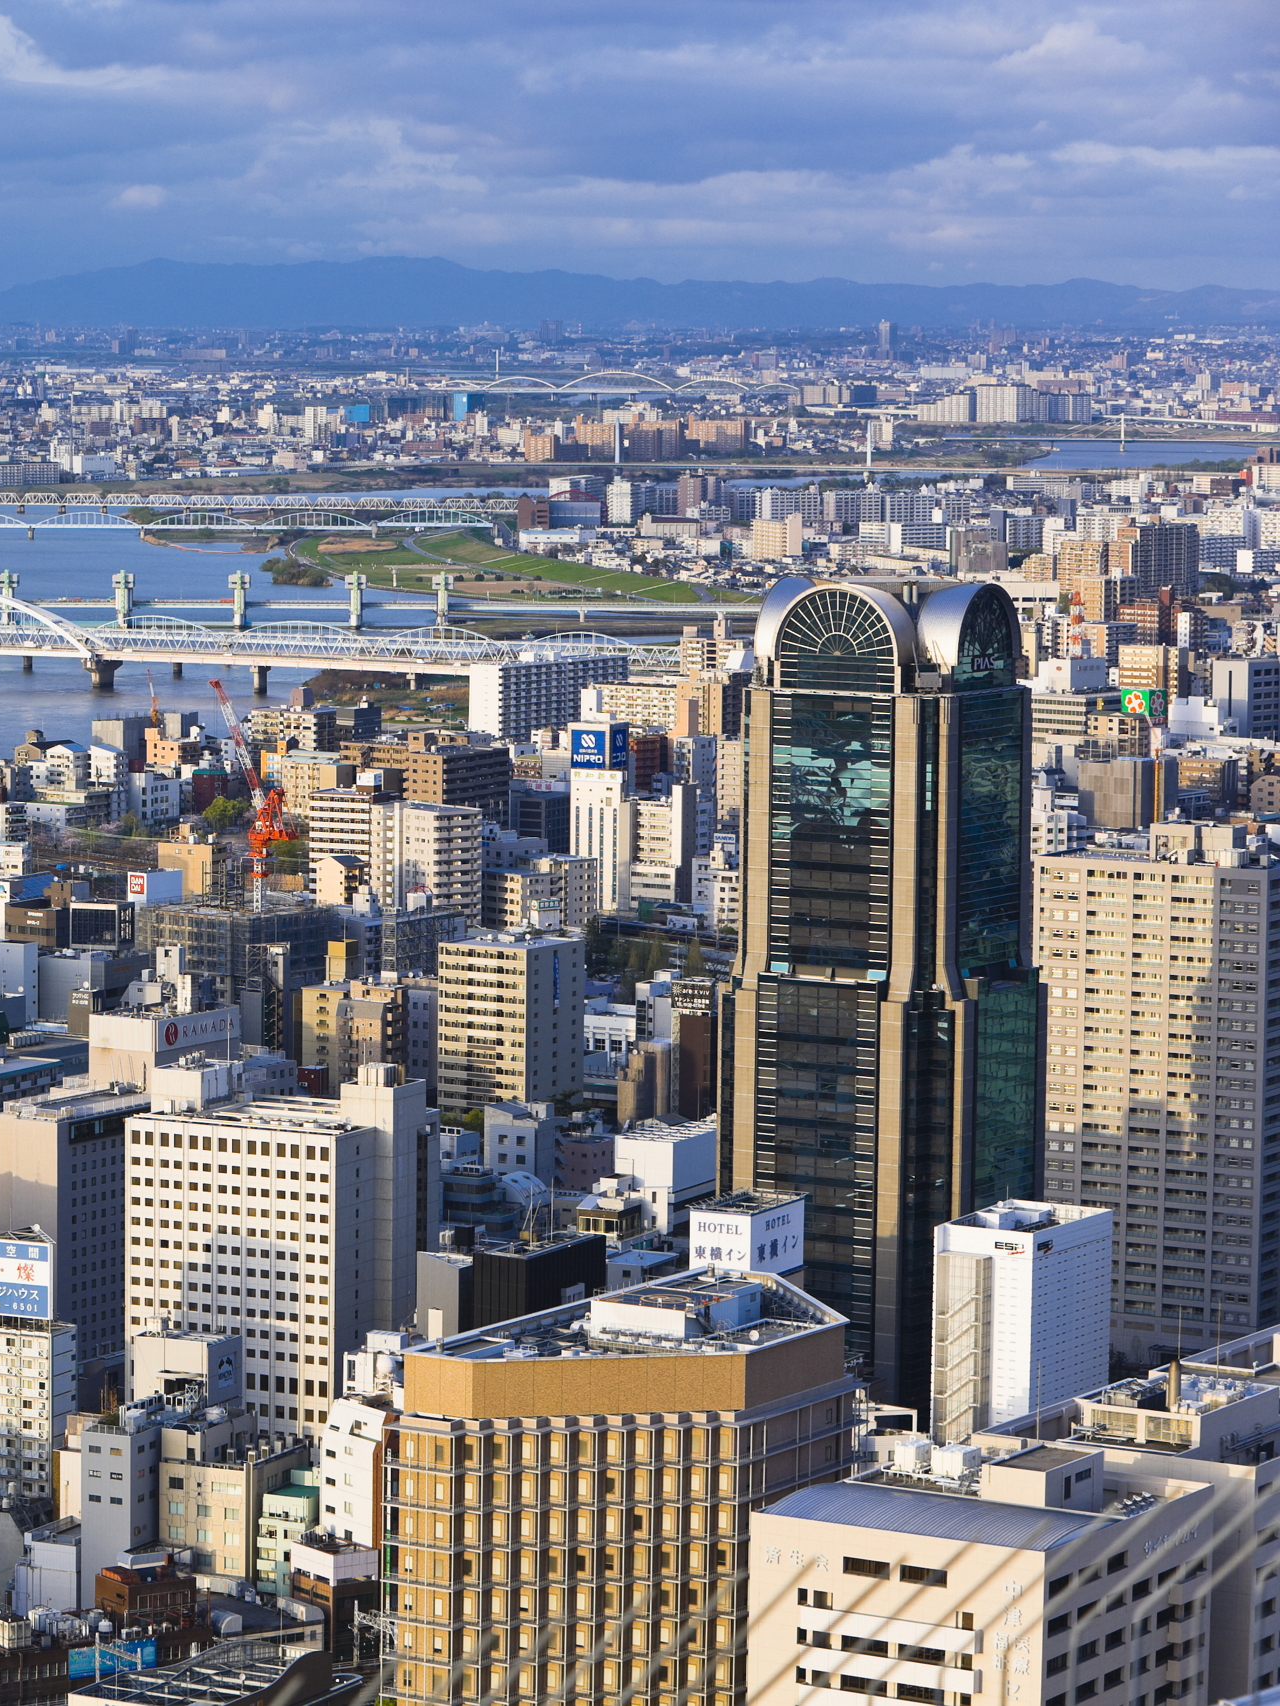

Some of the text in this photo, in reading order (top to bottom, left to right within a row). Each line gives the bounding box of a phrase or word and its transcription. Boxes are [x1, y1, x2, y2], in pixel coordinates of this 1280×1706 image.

[974, 656, 996, 670] PIAS
[573, 754, 603, 763] NIPRO
[573, 771, 617, 781] 報知新聞
[182, 1016, 235, 1038] RAMADA
[697, 1221, 742, 1236] HOTEL
[764, 1213, 792, 1232] HOTEL
[693, 1245, 746, 1262] 東横イン
[756, 1234, 799, 1264] 東横イン
[763, 1545, 829, 1571] 済生会
